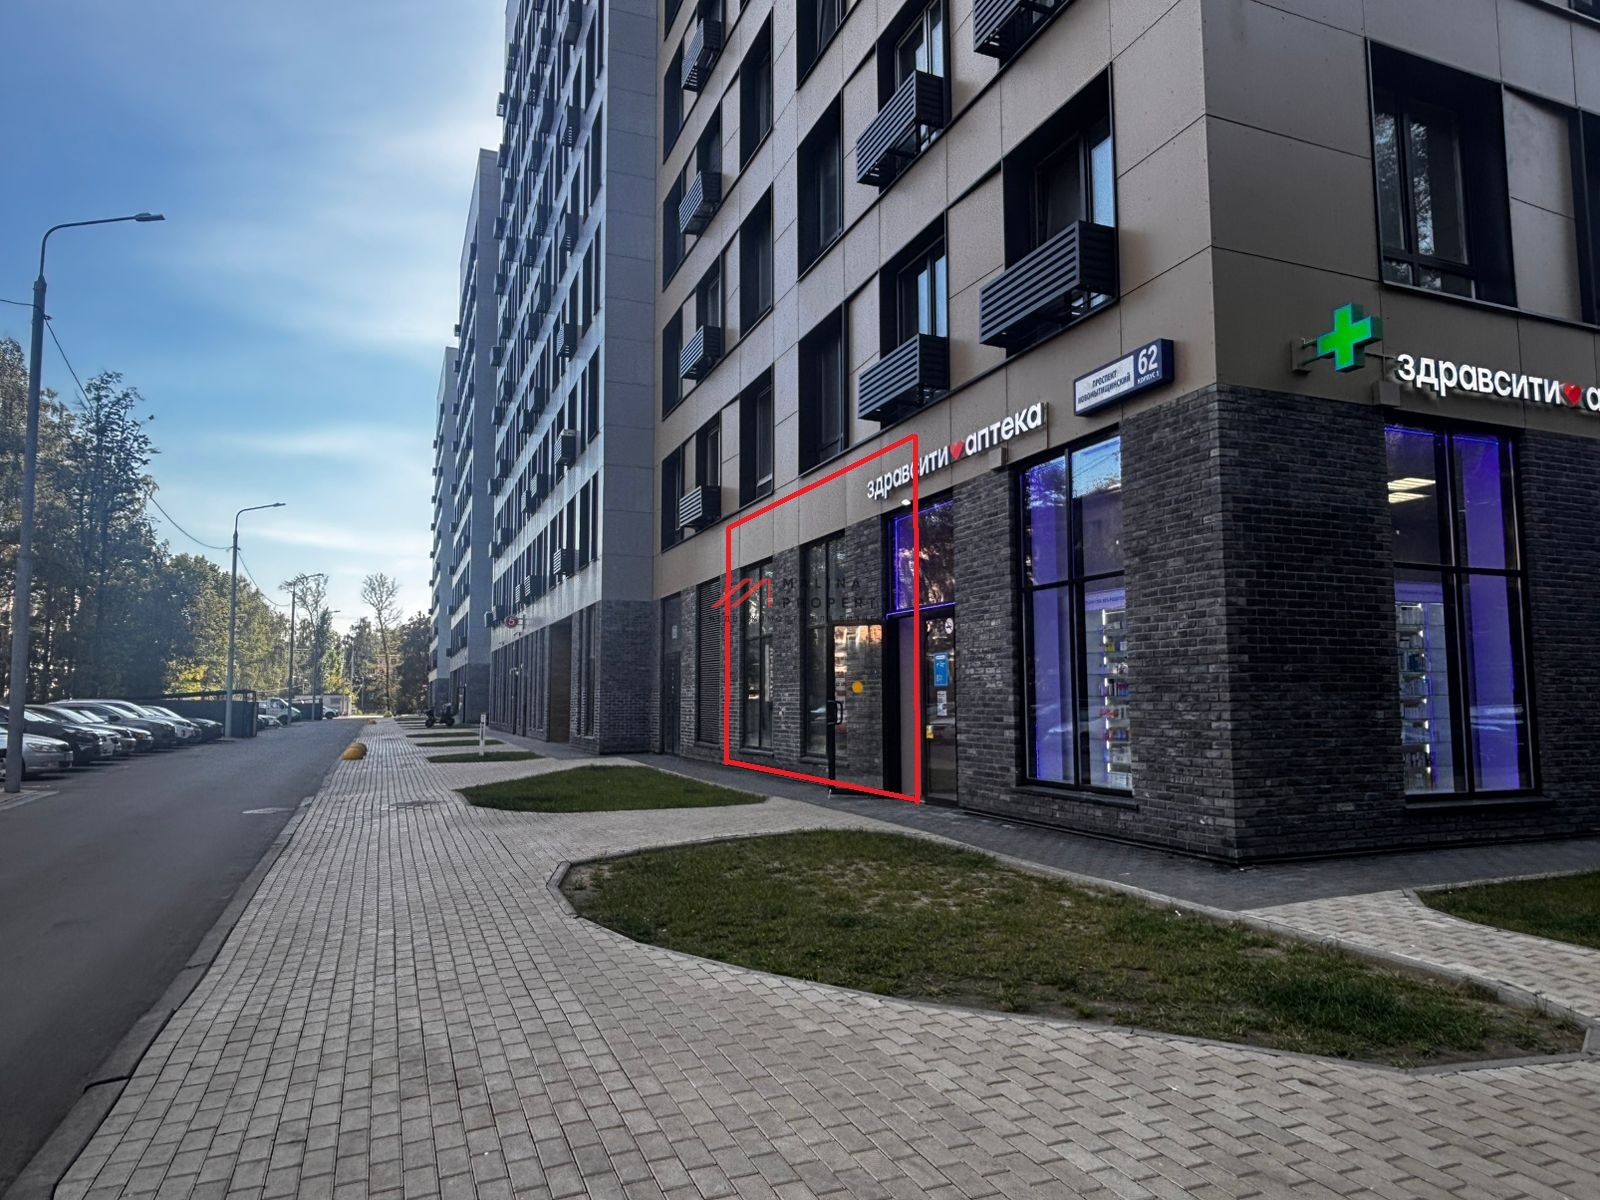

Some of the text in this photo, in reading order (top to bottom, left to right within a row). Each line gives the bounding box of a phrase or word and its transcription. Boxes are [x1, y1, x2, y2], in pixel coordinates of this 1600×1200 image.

[1092, 370, 1117, 388] ПРОСПЕКТ
[1138, 344, 1158, 375] 62
[1397, 354, 1561, 404] здравсити
[965, 402, 1042, 456] аптека
